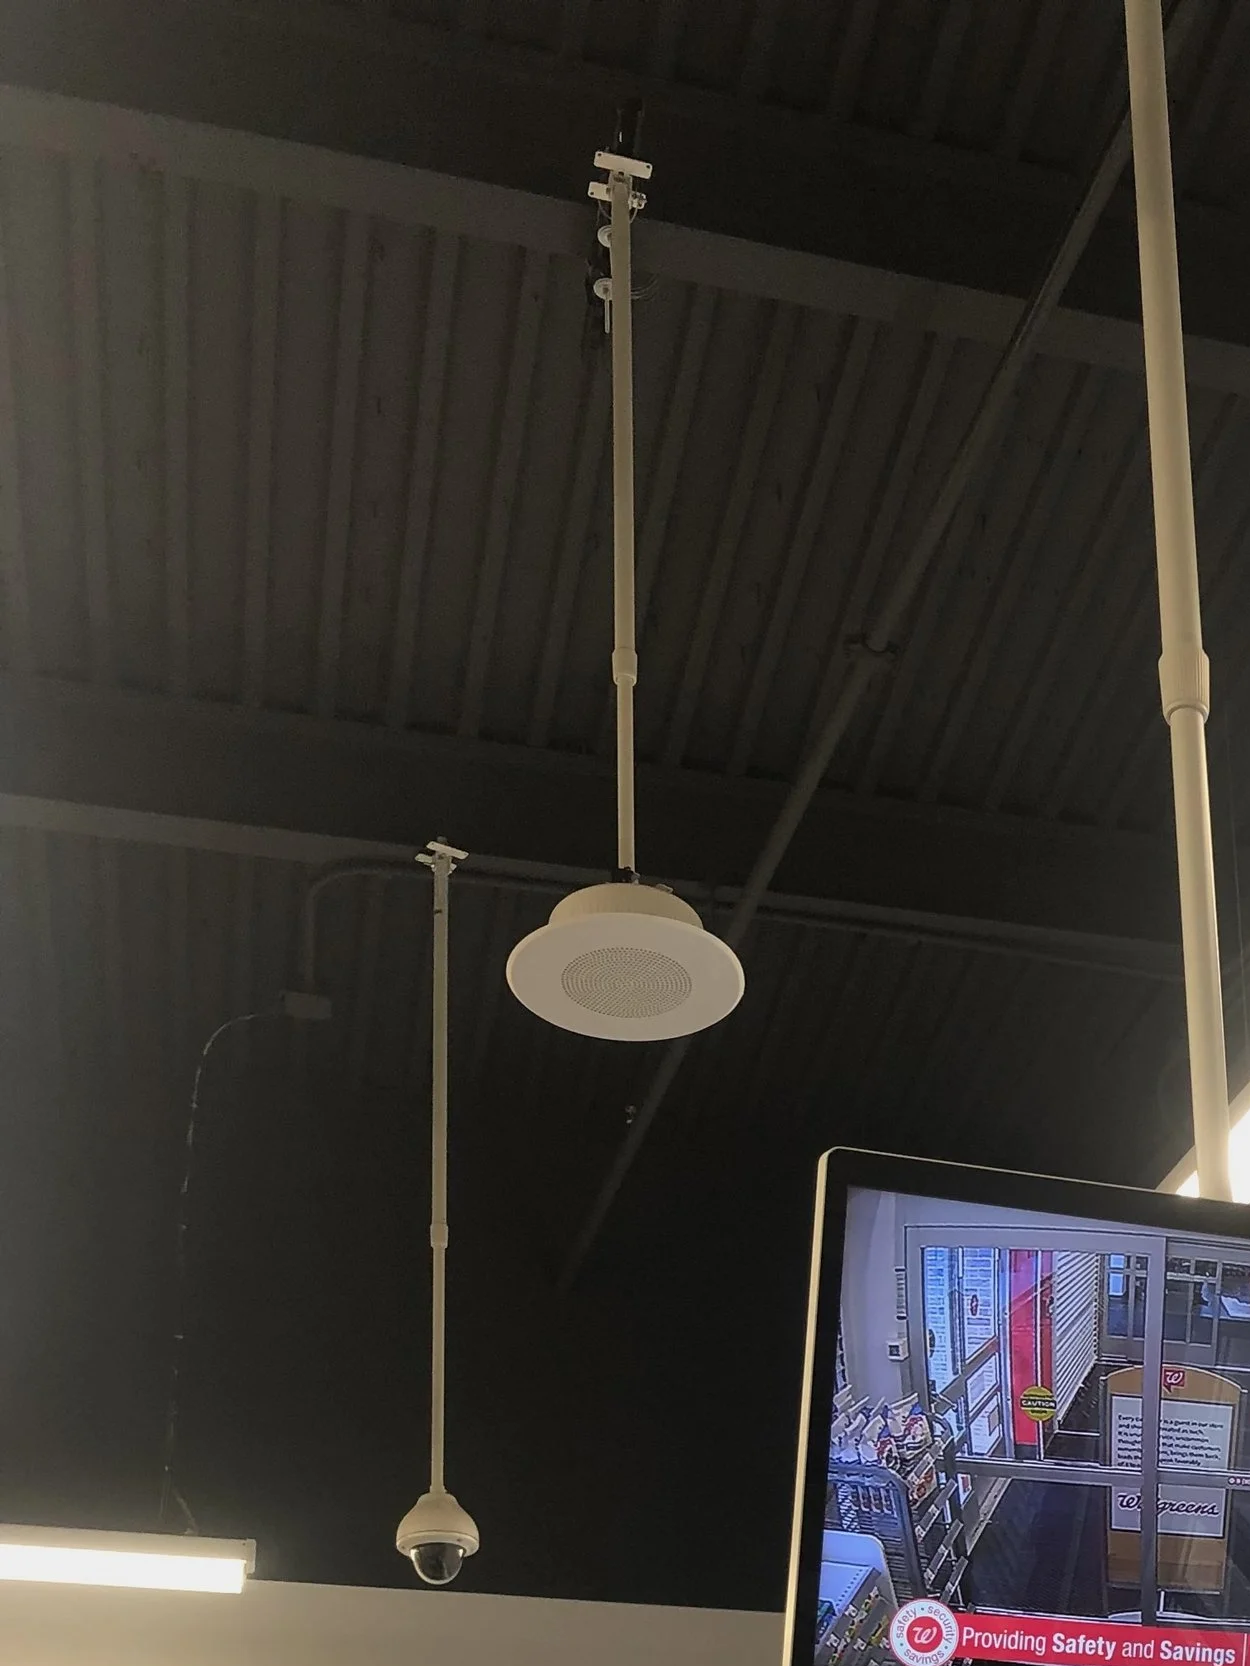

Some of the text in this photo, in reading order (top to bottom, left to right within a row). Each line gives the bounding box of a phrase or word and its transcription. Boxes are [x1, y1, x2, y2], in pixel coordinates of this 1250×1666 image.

[896, 1605, 956, 1644] safety security
[903, 1648, 945, 1664] savings
[962, 1626, 1236, 1665] Providing Safety and Savings
